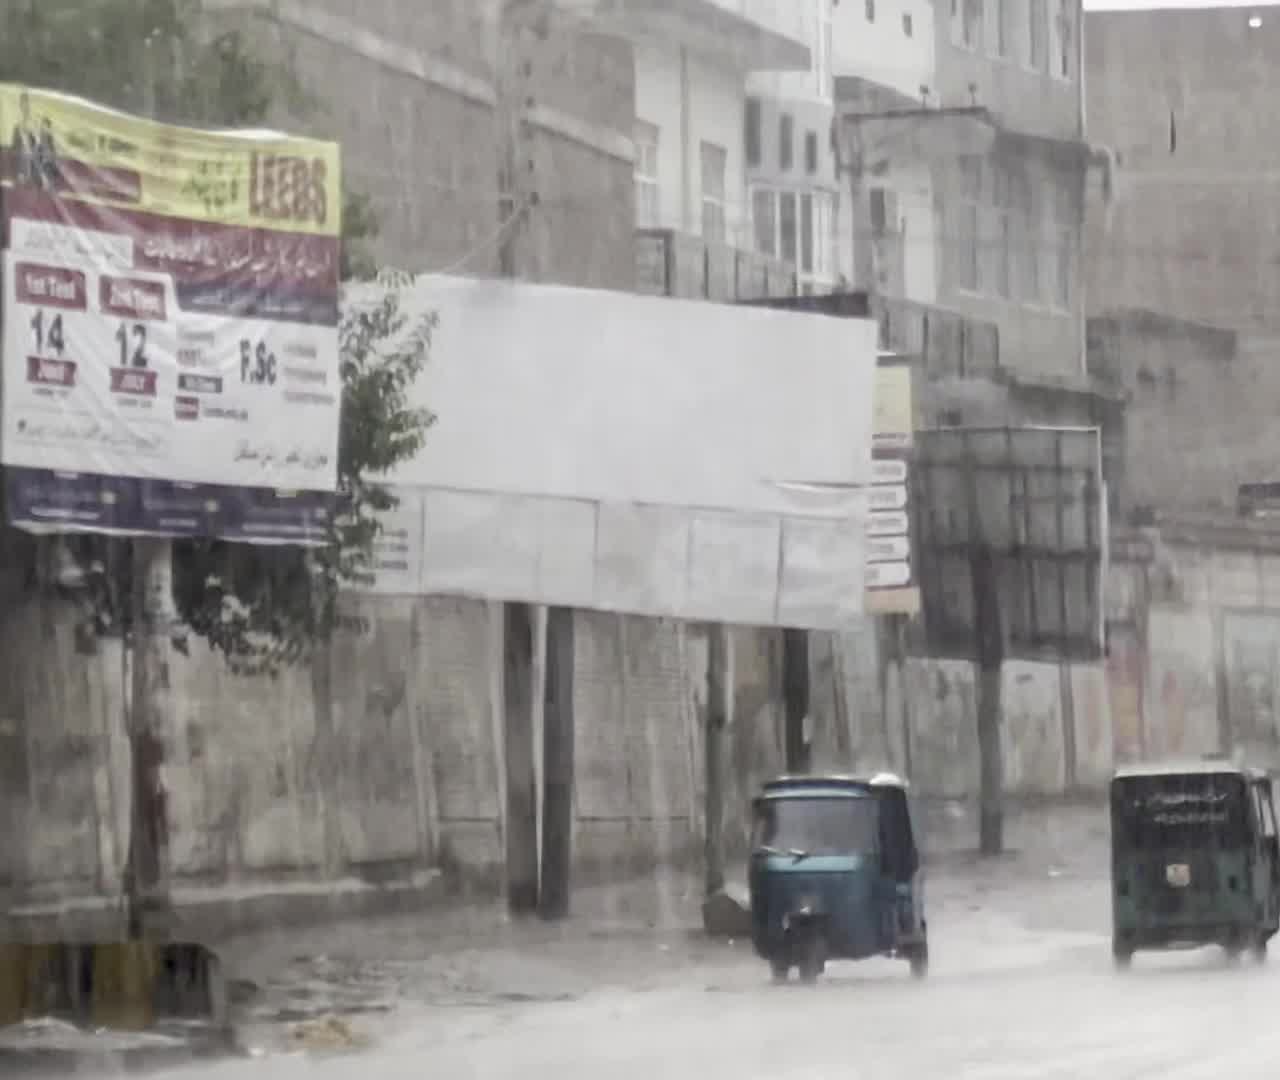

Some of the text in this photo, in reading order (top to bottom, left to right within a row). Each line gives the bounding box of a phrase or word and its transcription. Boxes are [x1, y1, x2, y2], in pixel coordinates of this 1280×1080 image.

[31, 308, 147, 367] 14 12
[239, 339, 276, 386] F.Sc
